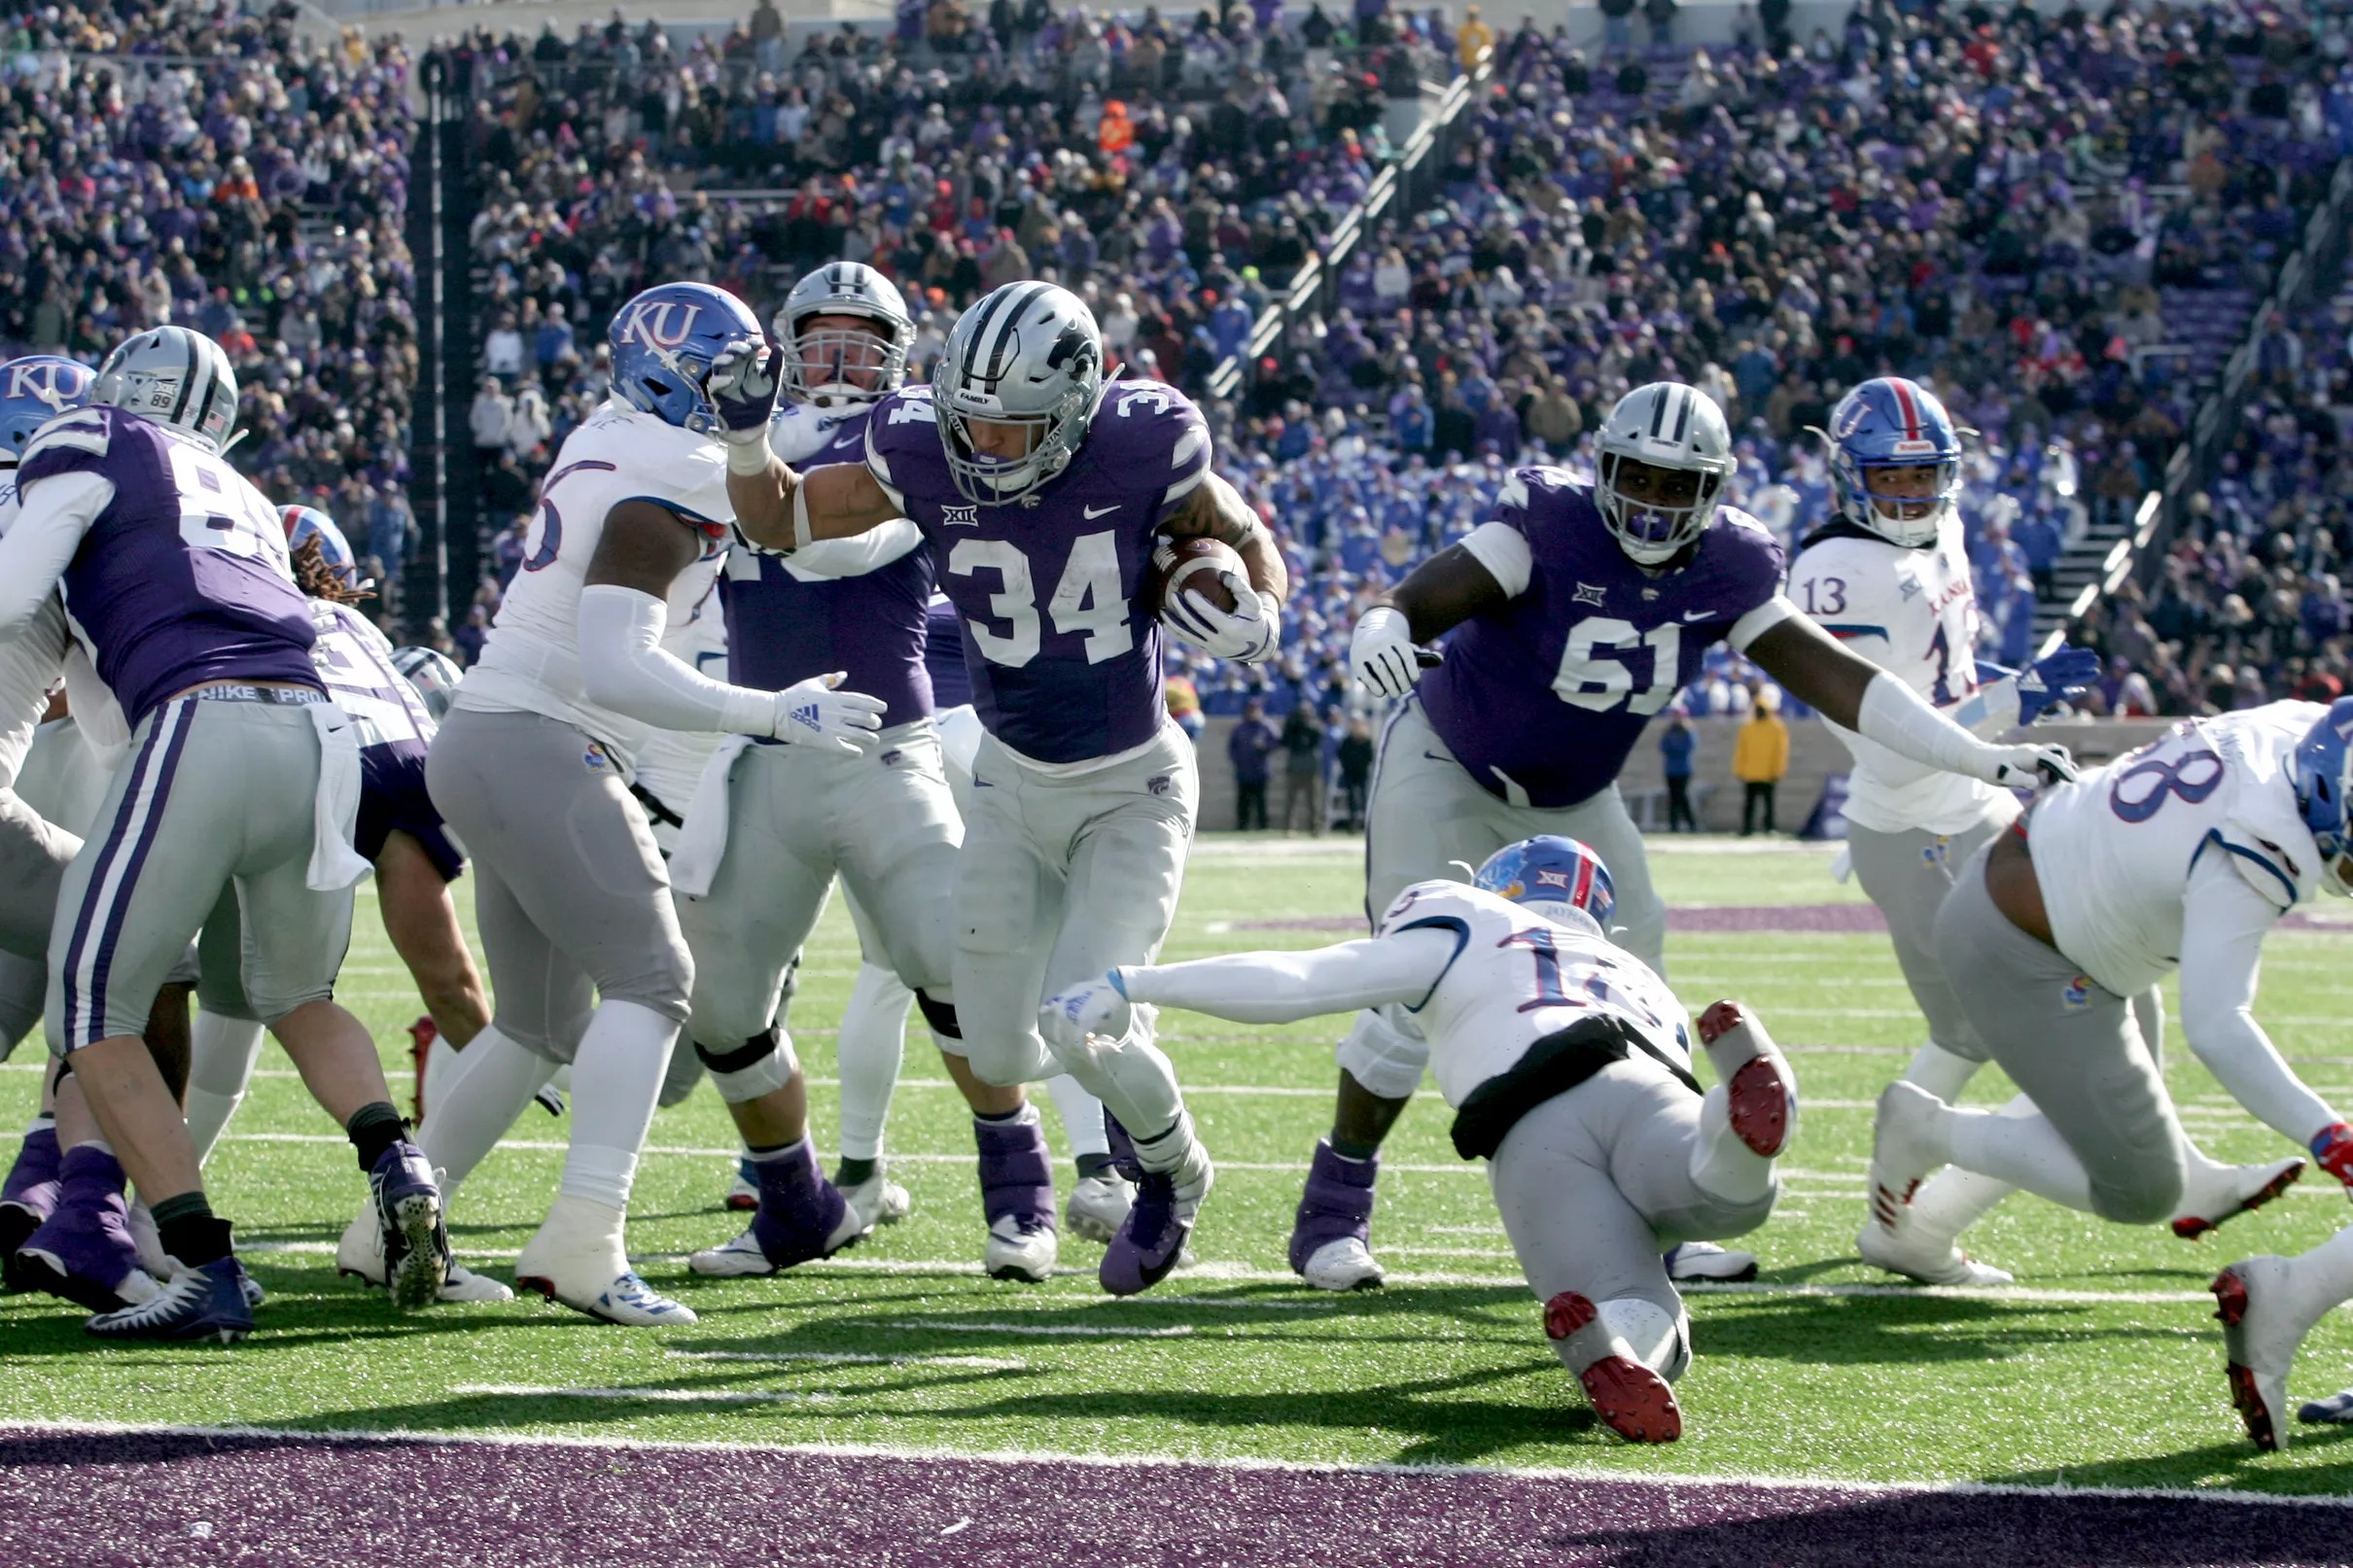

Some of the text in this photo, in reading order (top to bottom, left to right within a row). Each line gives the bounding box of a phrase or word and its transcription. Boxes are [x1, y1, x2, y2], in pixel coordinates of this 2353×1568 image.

[620, 301, 703, 354] KU
[6, 364, 87, 402] KU
[150, 394, 171, 408] 89
[960, 392, 990, 404] FAMILY
[941, 505, 978, 527] XII
[948, 530, 1133, 668] 34
[1572, 582, 1606, 608] XII
[1802, 576, 1846, 615] 13
[1551, 616, 1685, 715] 61
[197, 684, 258, 700] NIKE
[790, 712, 822, 733] adidas
[1536, 870, 1568, 889] XII
